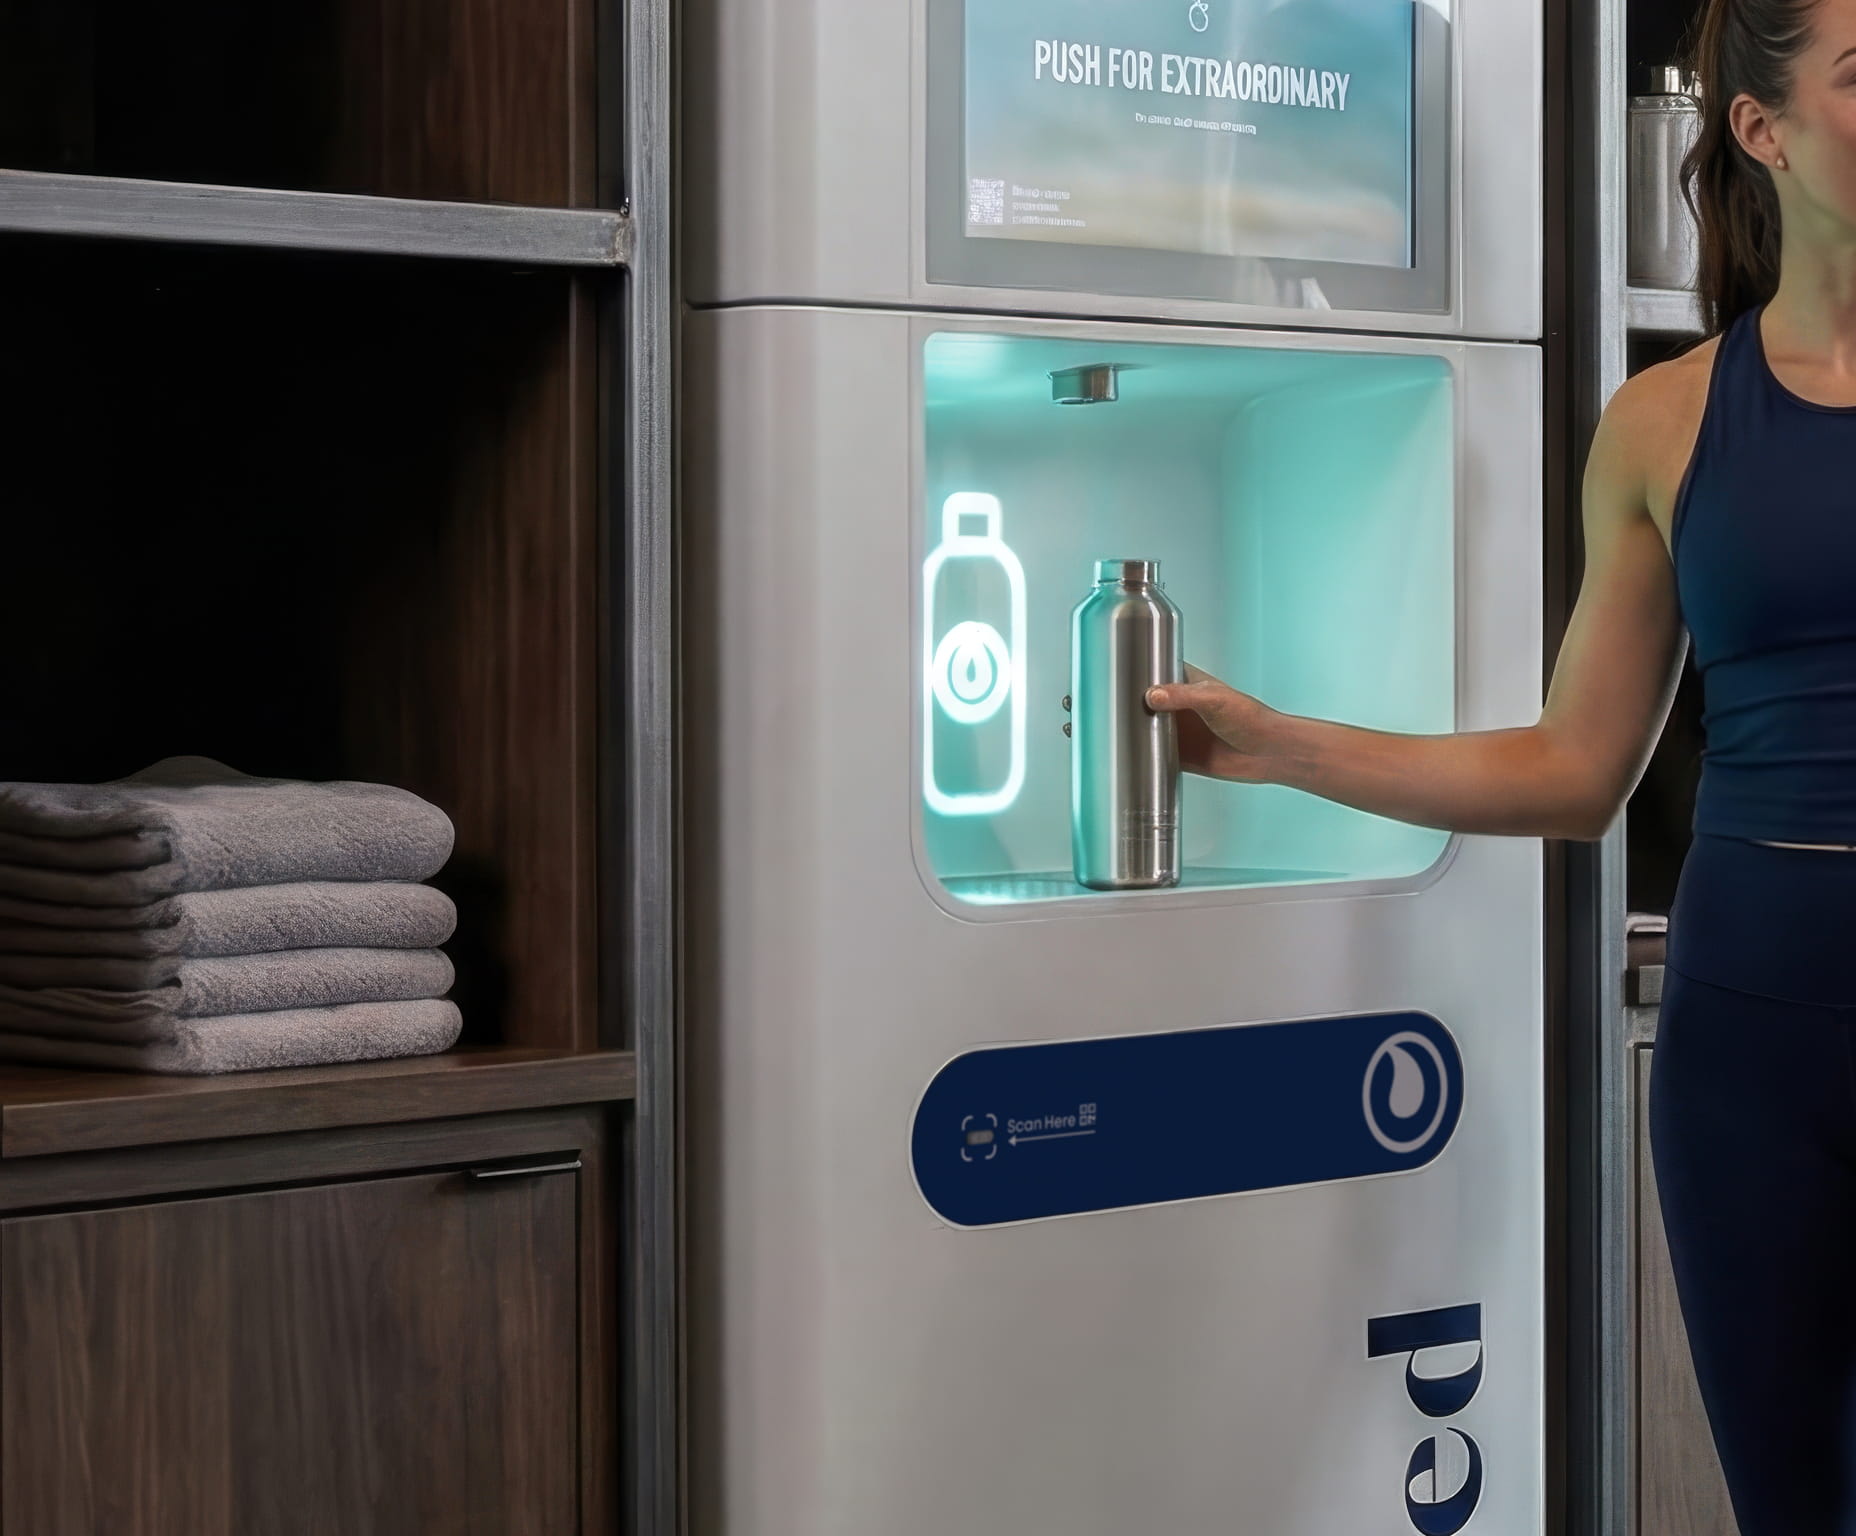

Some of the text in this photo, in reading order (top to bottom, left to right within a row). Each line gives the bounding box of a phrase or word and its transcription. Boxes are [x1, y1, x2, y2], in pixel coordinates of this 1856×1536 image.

[1034, 39, 1350, 111] PUSH FOR EXTRAORDINARY
[1007, 1115, 1076, 1133] Scan Here
